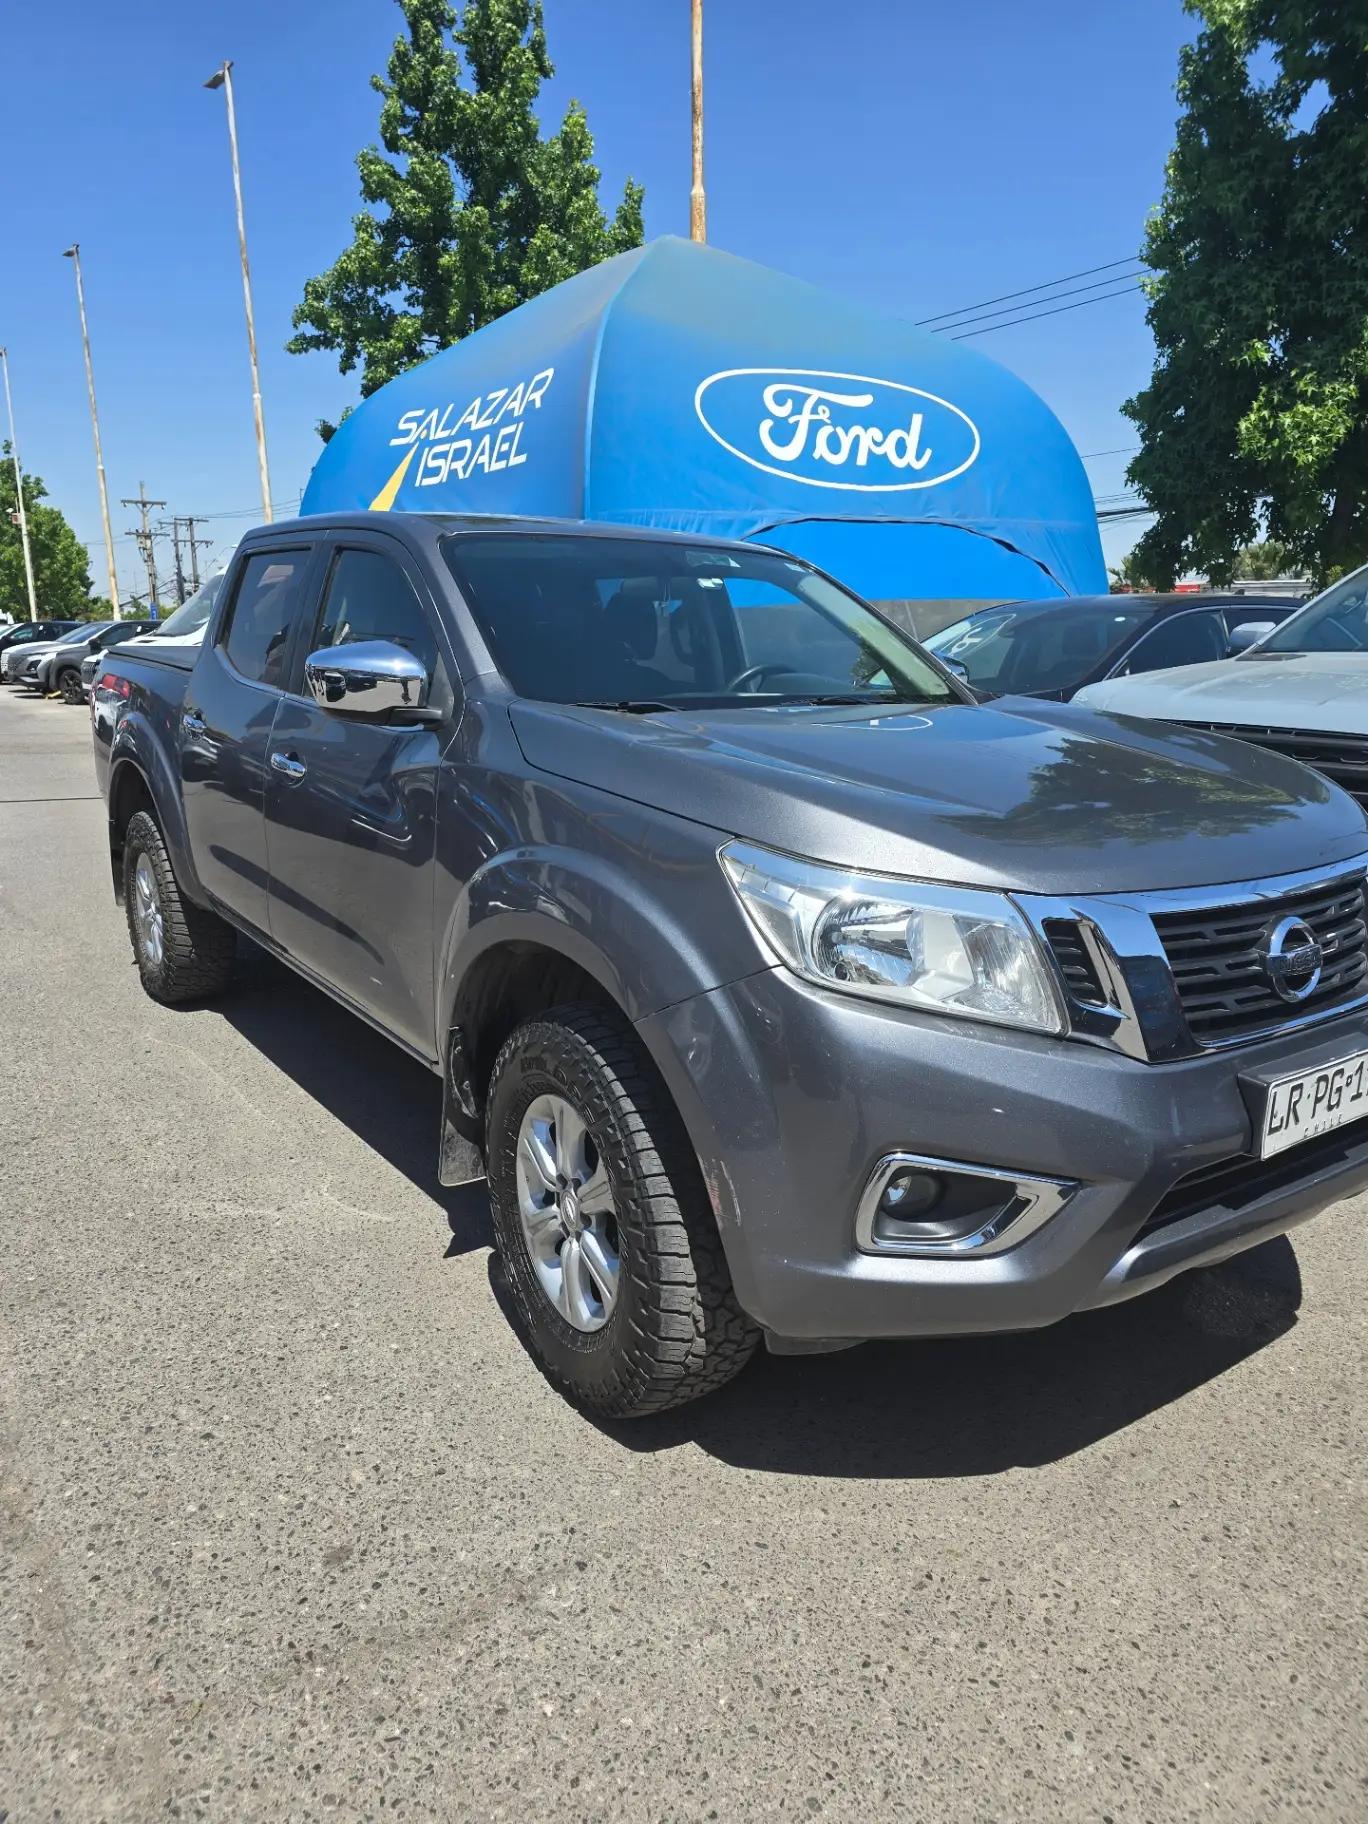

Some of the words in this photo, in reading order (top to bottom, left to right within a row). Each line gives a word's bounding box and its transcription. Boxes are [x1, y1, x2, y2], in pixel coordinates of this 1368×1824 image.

[389, 368, 555, 447] SALAZAR
[759, 383, 932, 470] Ford
[414, 421, 528, 487] ISRAEL
